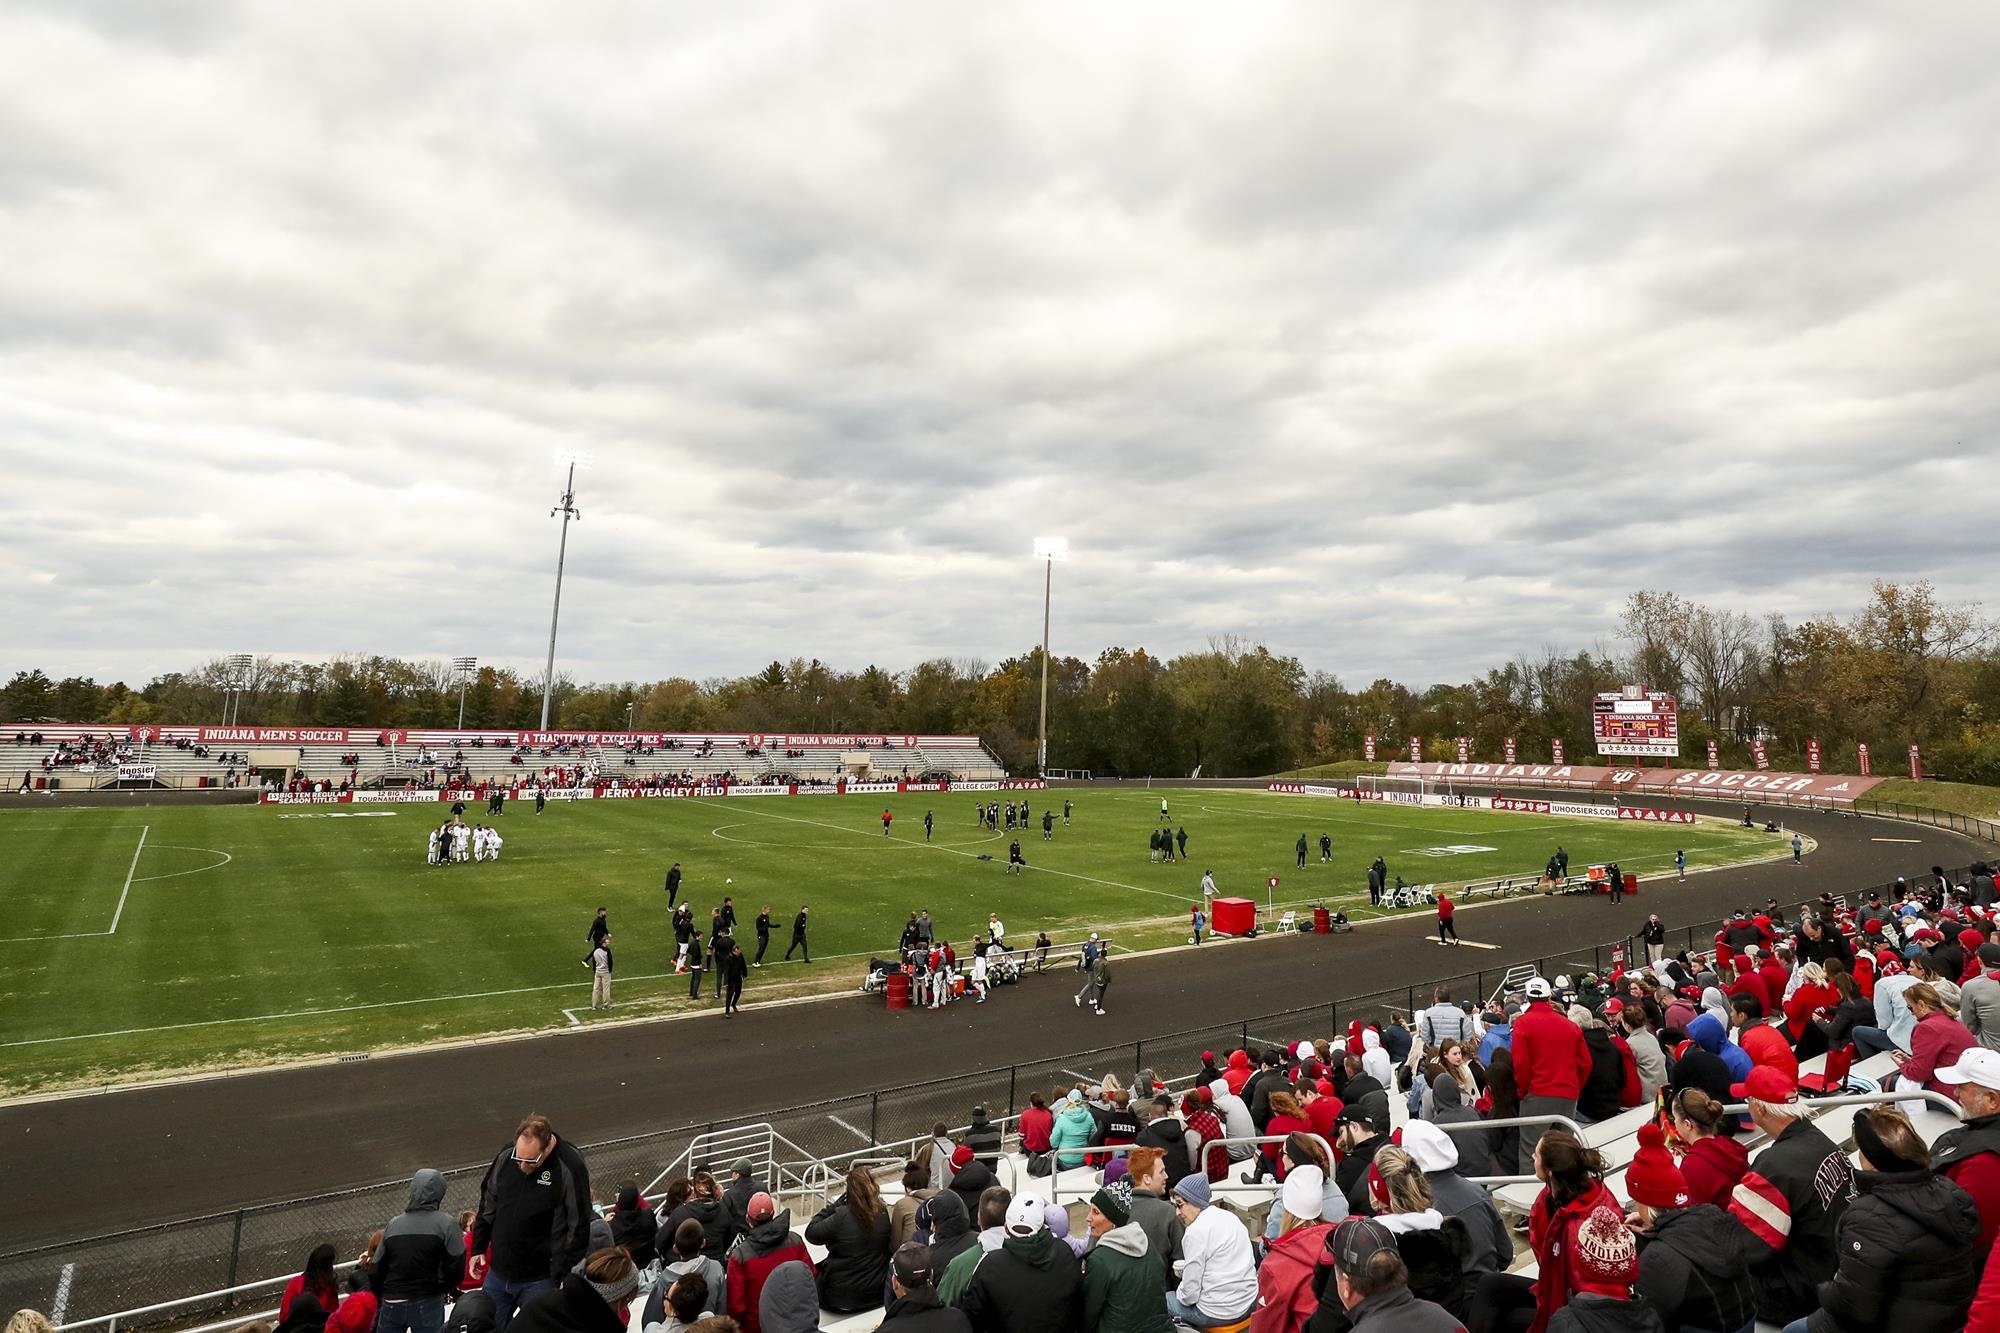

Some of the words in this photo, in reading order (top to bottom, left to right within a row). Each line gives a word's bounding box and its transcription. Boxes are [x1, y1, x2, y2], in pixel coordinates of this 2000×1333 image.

[204, 729, 256, 740] INDIANA
[260, 730, 296, 740] MEN'S
[300, 730, 343, 741] SOCCER
[522, 733, 530, 742] A
[588, 734, 599, 744] OF
[788, 736, 819, 745] INDIANA
[822, 736, 855, 745] WOMEN'S
[120, 766, 155, 775] Hoosier
[1435, 764, 1572, 776] INDIANA
[1676, 772, 1814, 791] SOCCER
[600, 788, 636, 798] JERRY
[640, 787, 693, 798] YEAGLEY
[694, 786, 724, 796] FIELD
[1442, 796, 1480, 807] SOCER
[1552, 805, 1618, 816] IUHOOSIERS.COM
[1584, 1238, 1634, 1260] INDIANA
